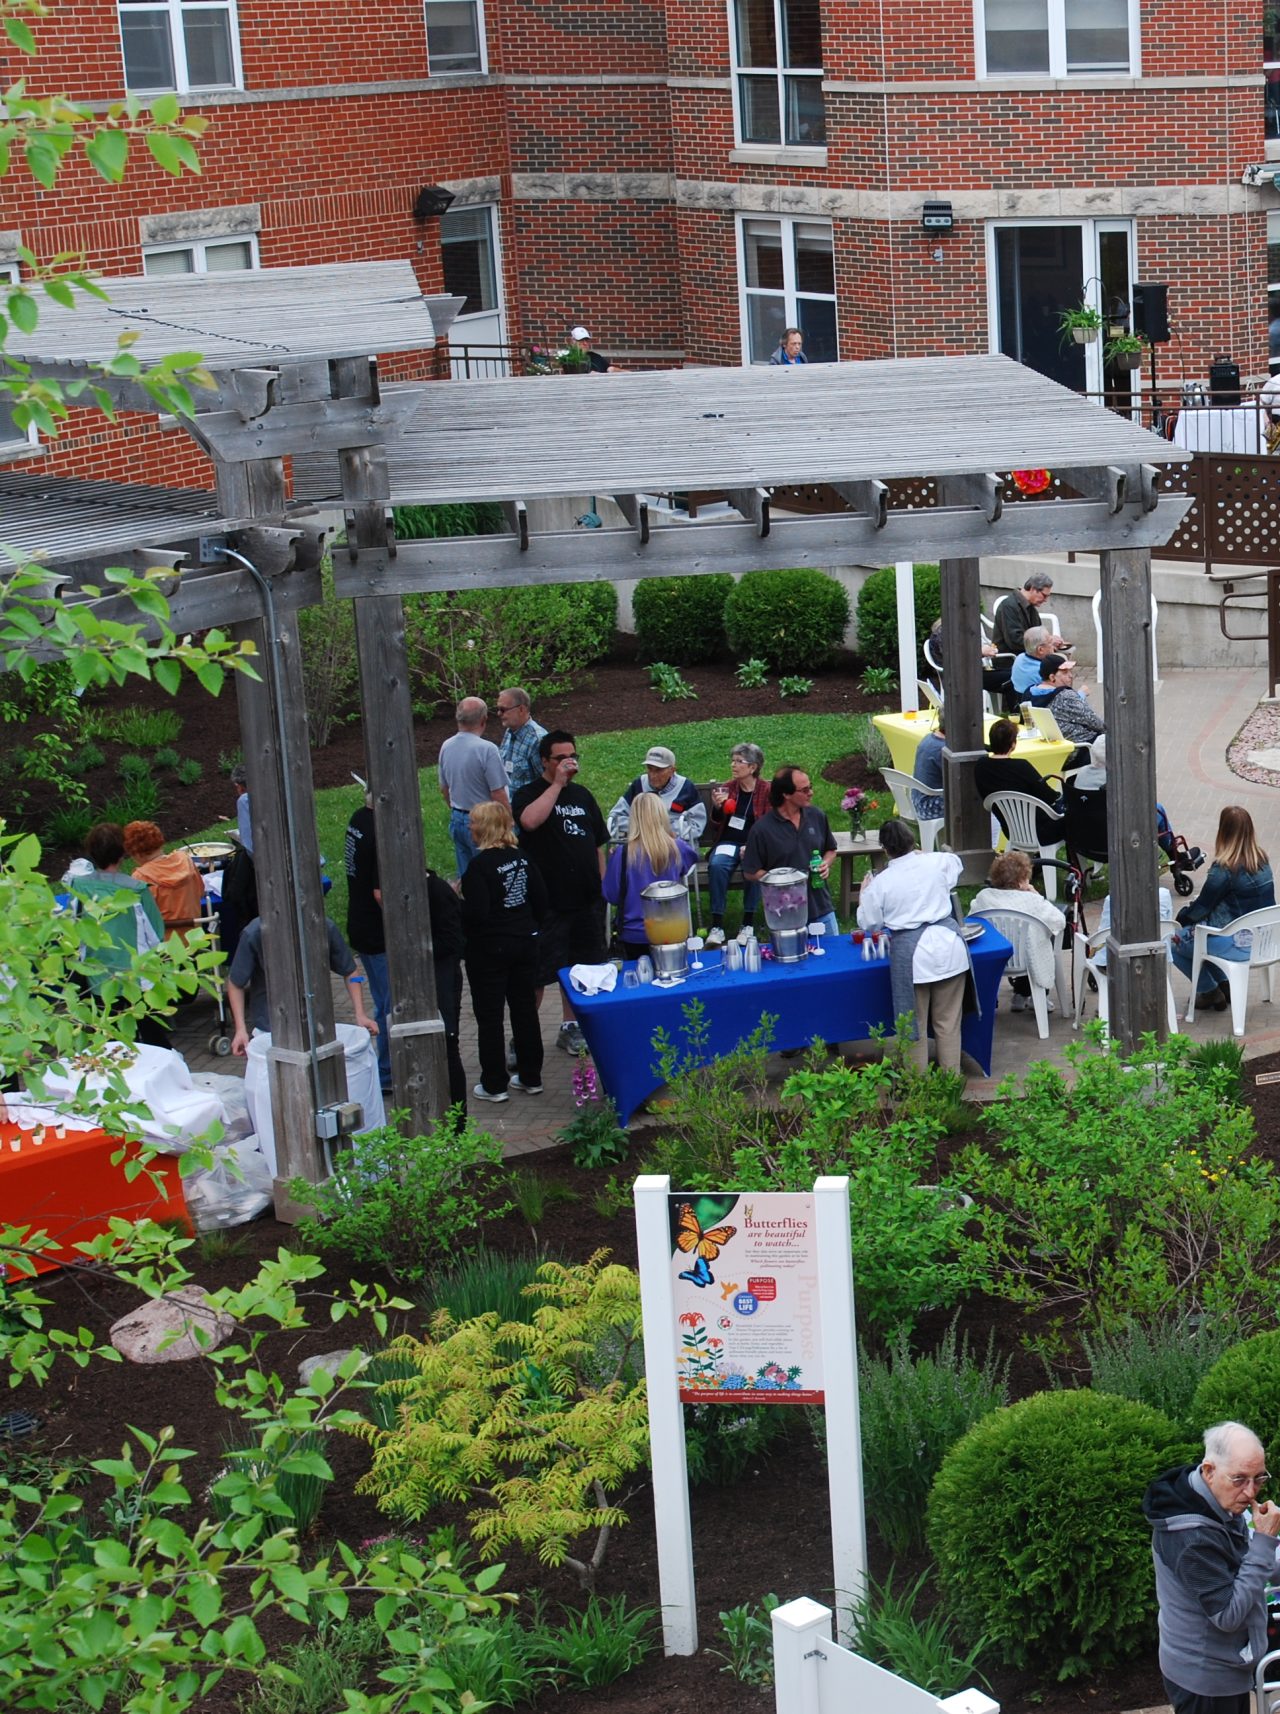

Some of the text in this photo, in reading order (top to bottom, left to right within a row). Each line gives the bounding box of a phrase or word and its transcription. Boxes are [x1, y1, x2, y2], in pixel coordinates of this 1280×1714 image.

[744, 1217, 808, 1229] Butterflies
[764, 1229, 806, 1241] beautiful
[793, 1274, 817, 1361] Purpose
